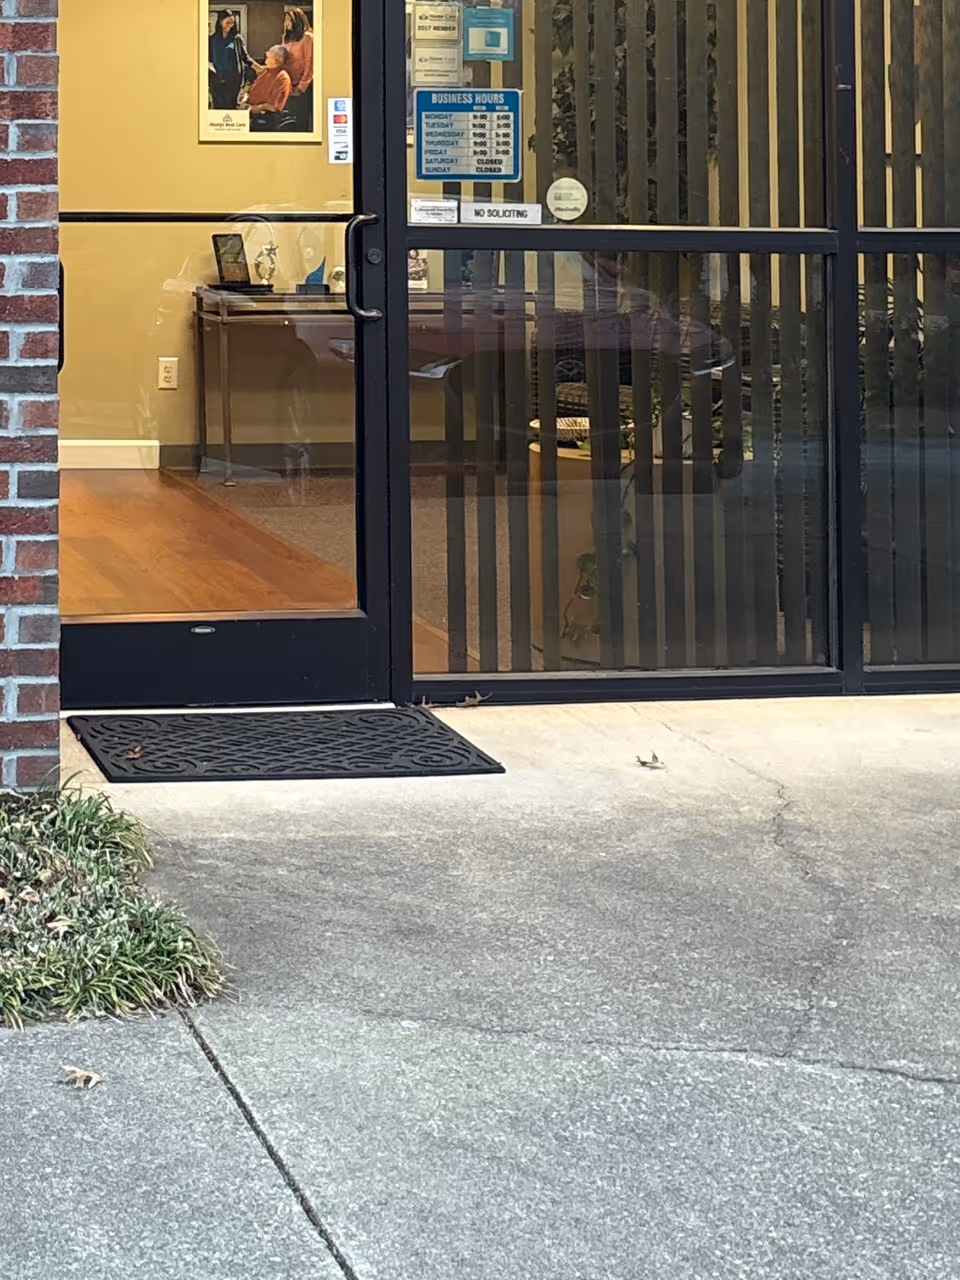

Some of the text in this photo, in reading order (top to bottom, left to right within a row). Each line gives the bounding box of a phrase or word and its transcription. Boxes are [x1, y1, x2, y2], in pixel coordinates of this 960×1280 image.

[431, 93, 505, 104] BUSINESS HOURS
[474, 209, 528, 218] NO SOLICITING
